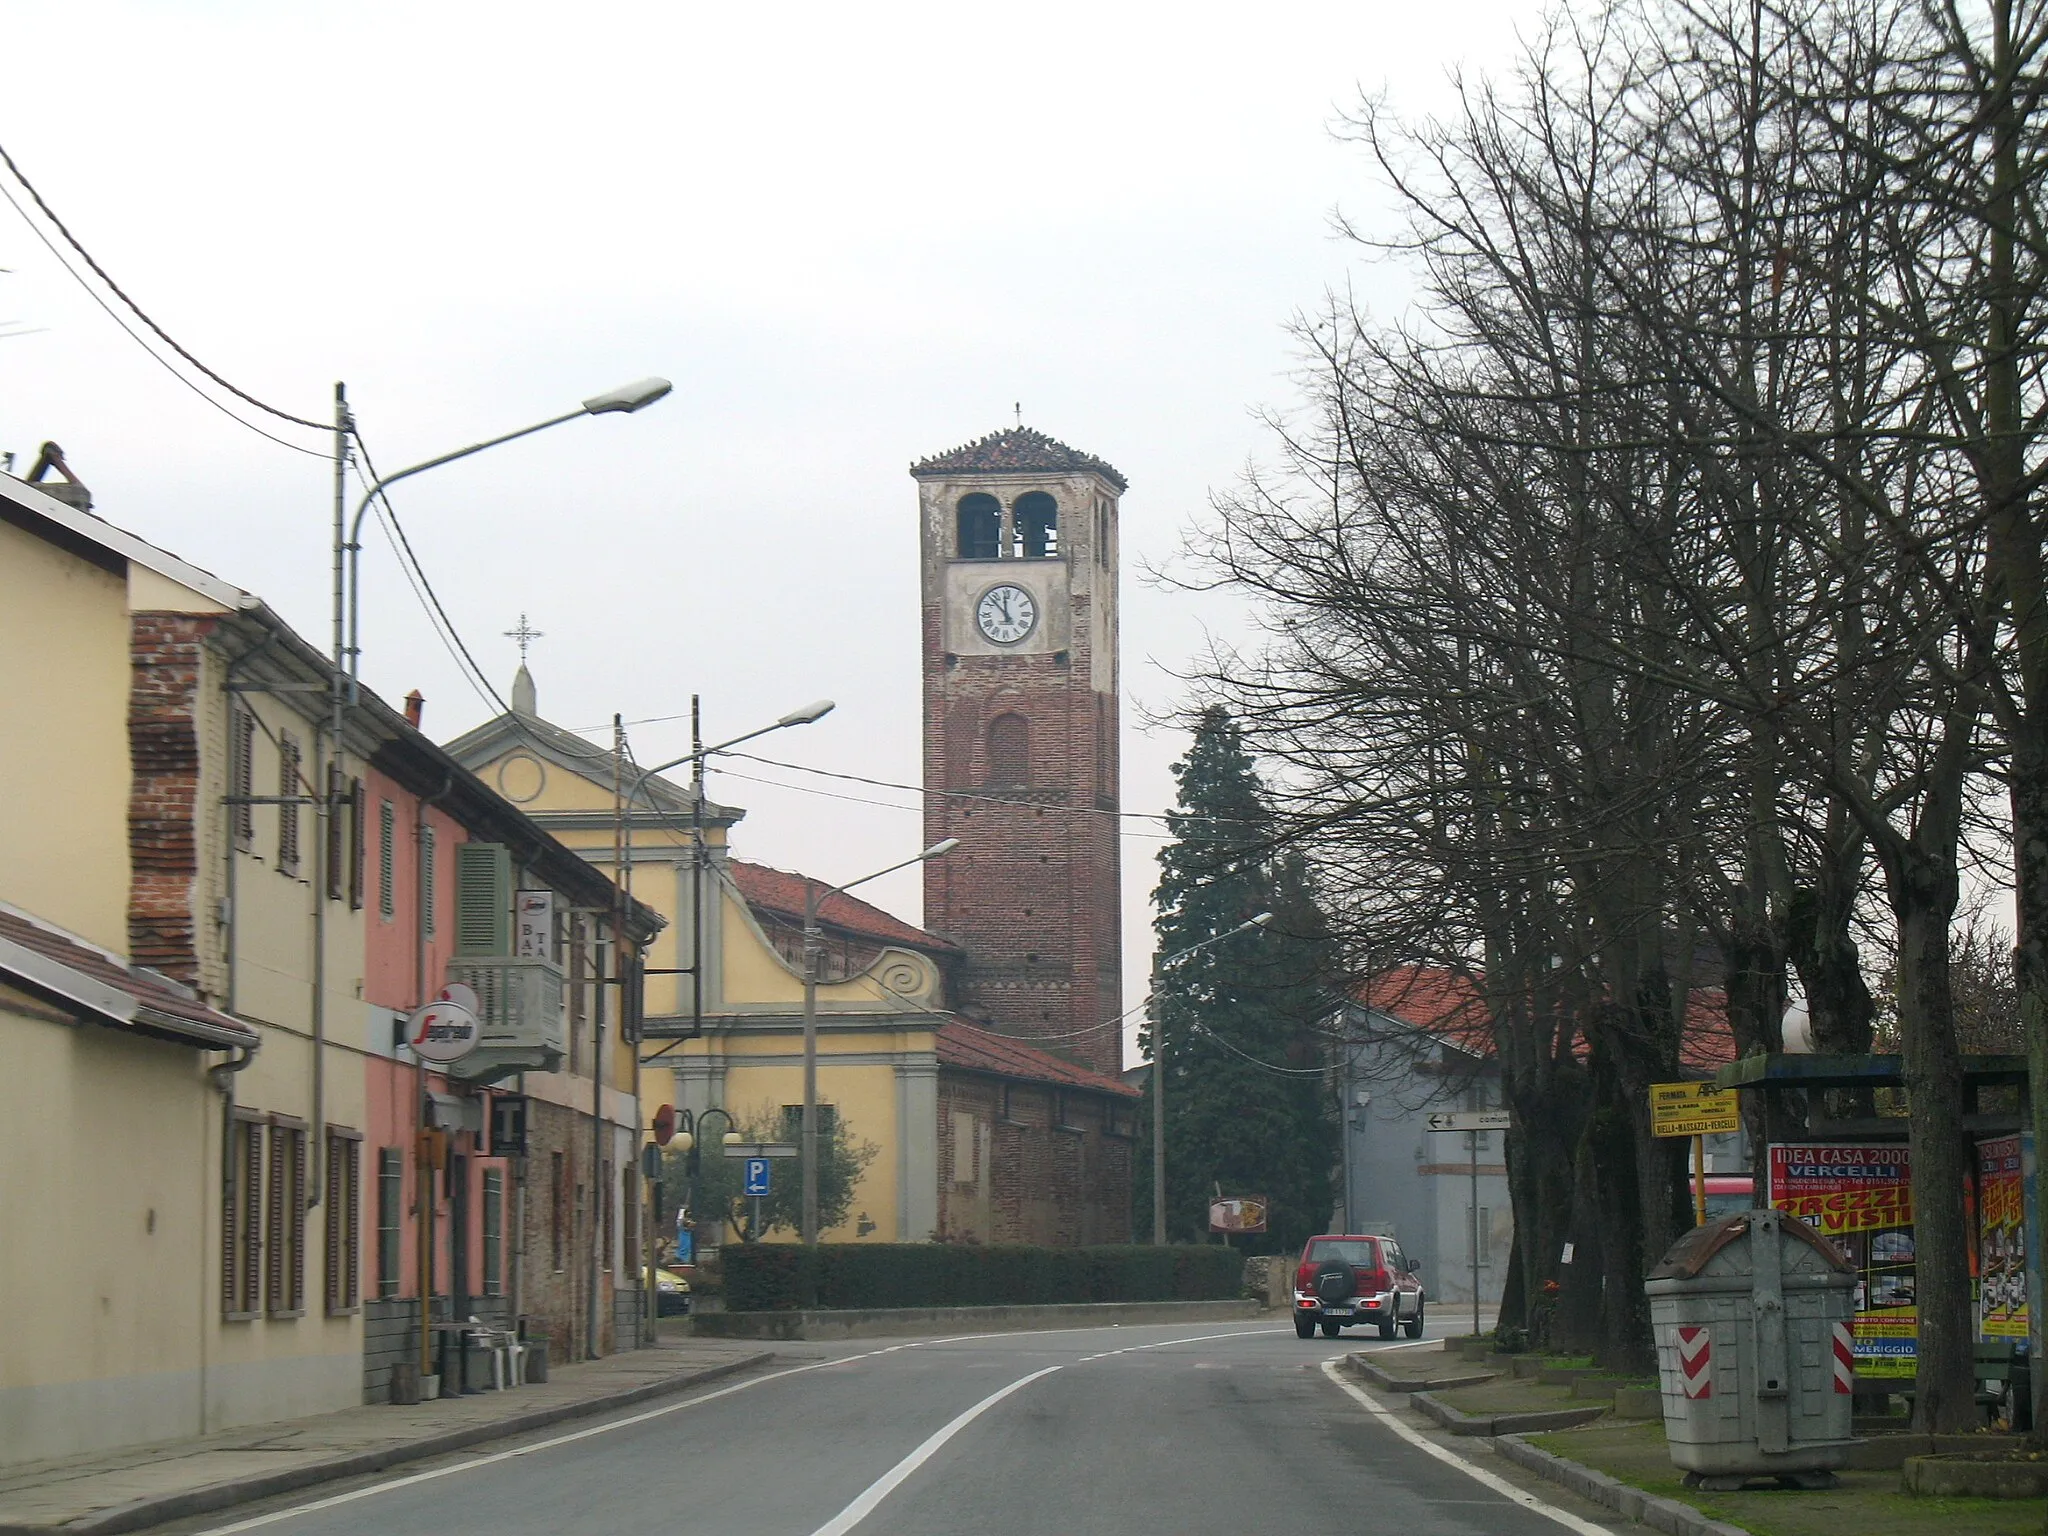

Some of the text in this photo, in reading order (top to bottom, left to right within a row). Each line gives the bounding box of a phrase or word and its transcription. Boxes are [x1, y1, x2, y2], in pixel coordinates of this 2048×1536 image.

[1776, 1149, 1816, 1164] IDEA
[1819, 1149, 1864, 1164] CASA
[751, 1162, 764, 1181] P
[1788, 1165, 1896, 1177] VERCELLI
[1823, 1207, 1911, 1229] VISTI
[1854, 1346, 1914, 1354] MERIGGIO
